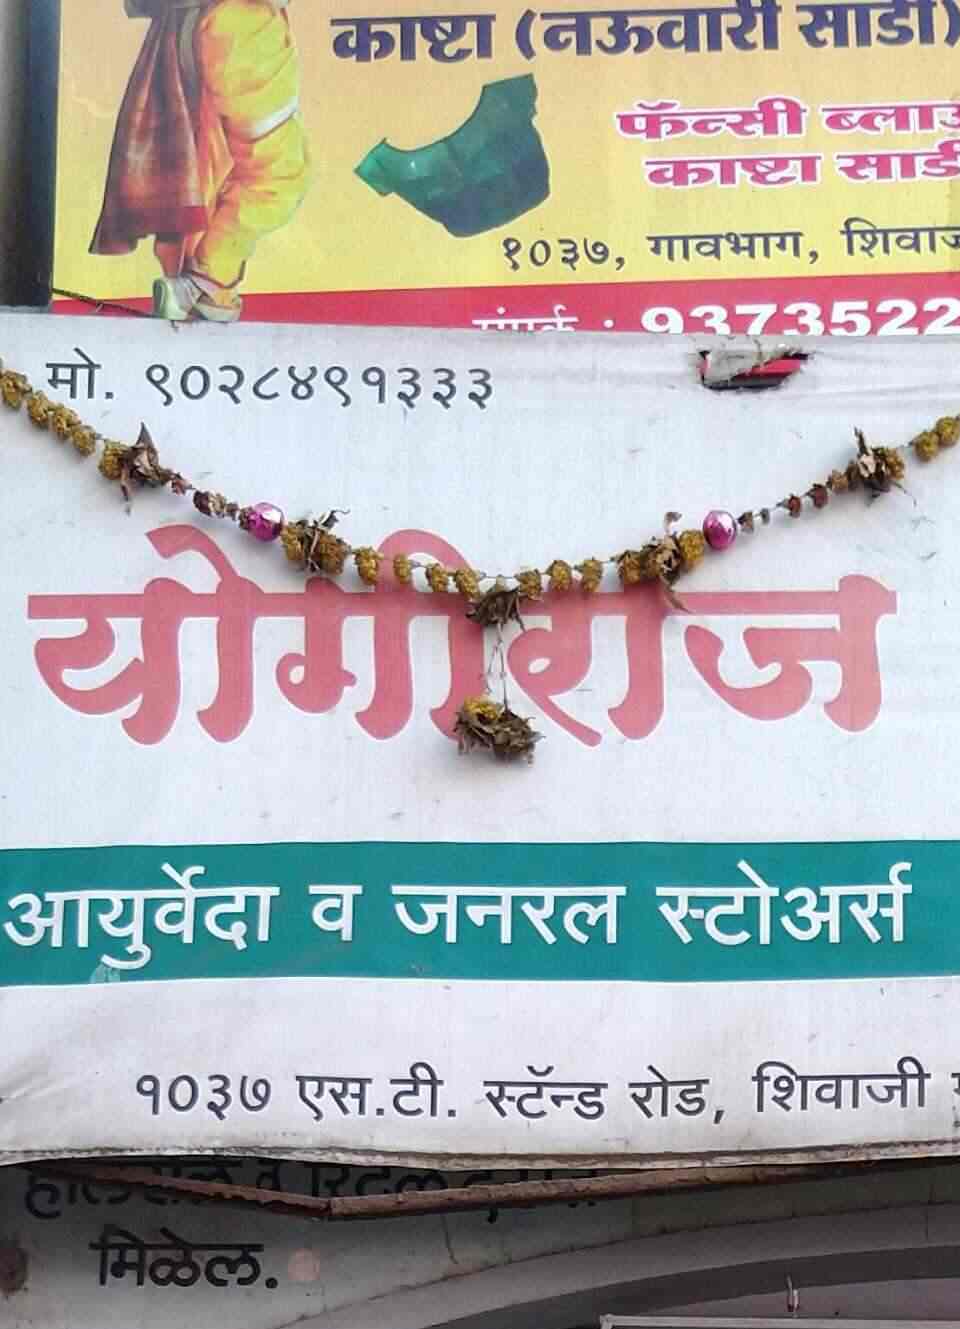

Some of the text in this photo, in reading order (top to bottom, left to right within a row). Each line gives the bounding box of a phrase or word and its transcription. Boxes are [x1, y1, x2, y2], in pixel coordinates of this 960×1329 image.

[329, 13, 497, 63] काष्टा
[615, 96, 806, 140] फॅन्सी
[645, 154, 822, 187] काष्टा
[647, 230, 820, 265] गावभाग,
[46, 347, 494, 410] मो. ९०२८४९१३३३
[27, 523, 898, 748] योगीराज
[3, 859, 914, 971] आयुर्वेदा व जनरल स्टोअर्स
[135, 1071, 272, 1120] १०३७
[482, 1064, 607, 1121] स्टॅन्ड
[628, 1065, 726, 1124] रोड,
[751, 1056, 931, 1114] शिवाजी
[88, 1227, 279, 1290] मिळेल.
